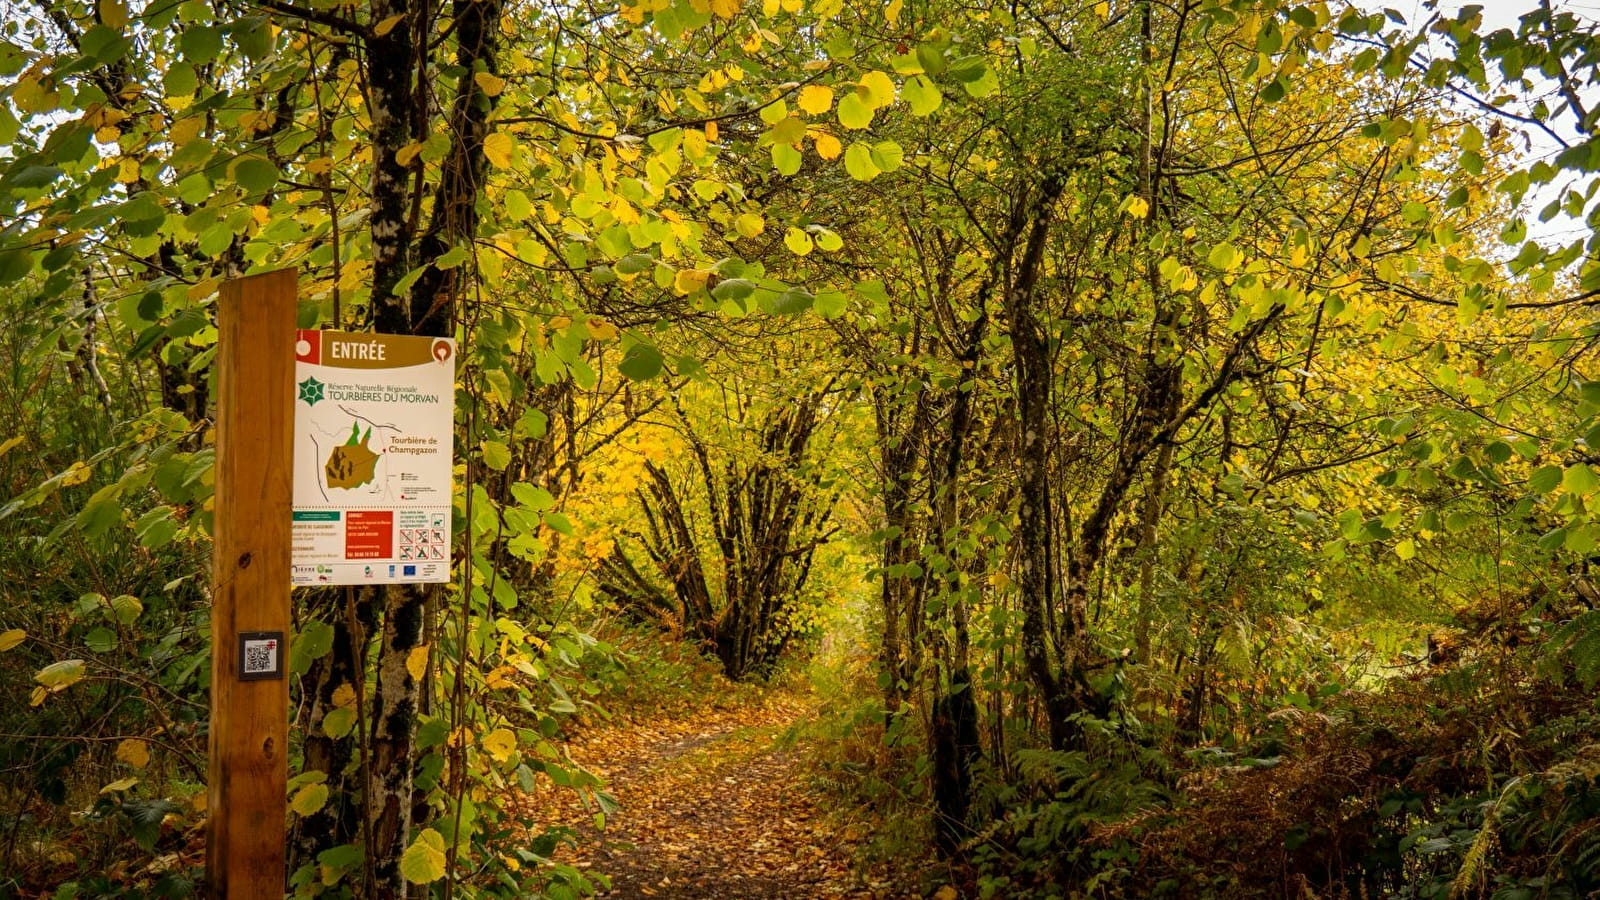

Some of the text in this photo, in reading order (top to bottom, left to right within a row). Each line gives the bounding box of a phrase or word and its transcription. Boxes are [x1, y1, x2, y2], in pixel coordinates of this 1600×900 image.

[332, 340, 386, 361] ENTRÉE
[328, 383, 418, 393] Réserve Naturelle Régionale
[384, 393, 398, 402] DU
[400, 394, 439, 404] MORVAN
[391, 436, 438, 444] Tourbière de
[388, 446, 438, 456] Champgazon
